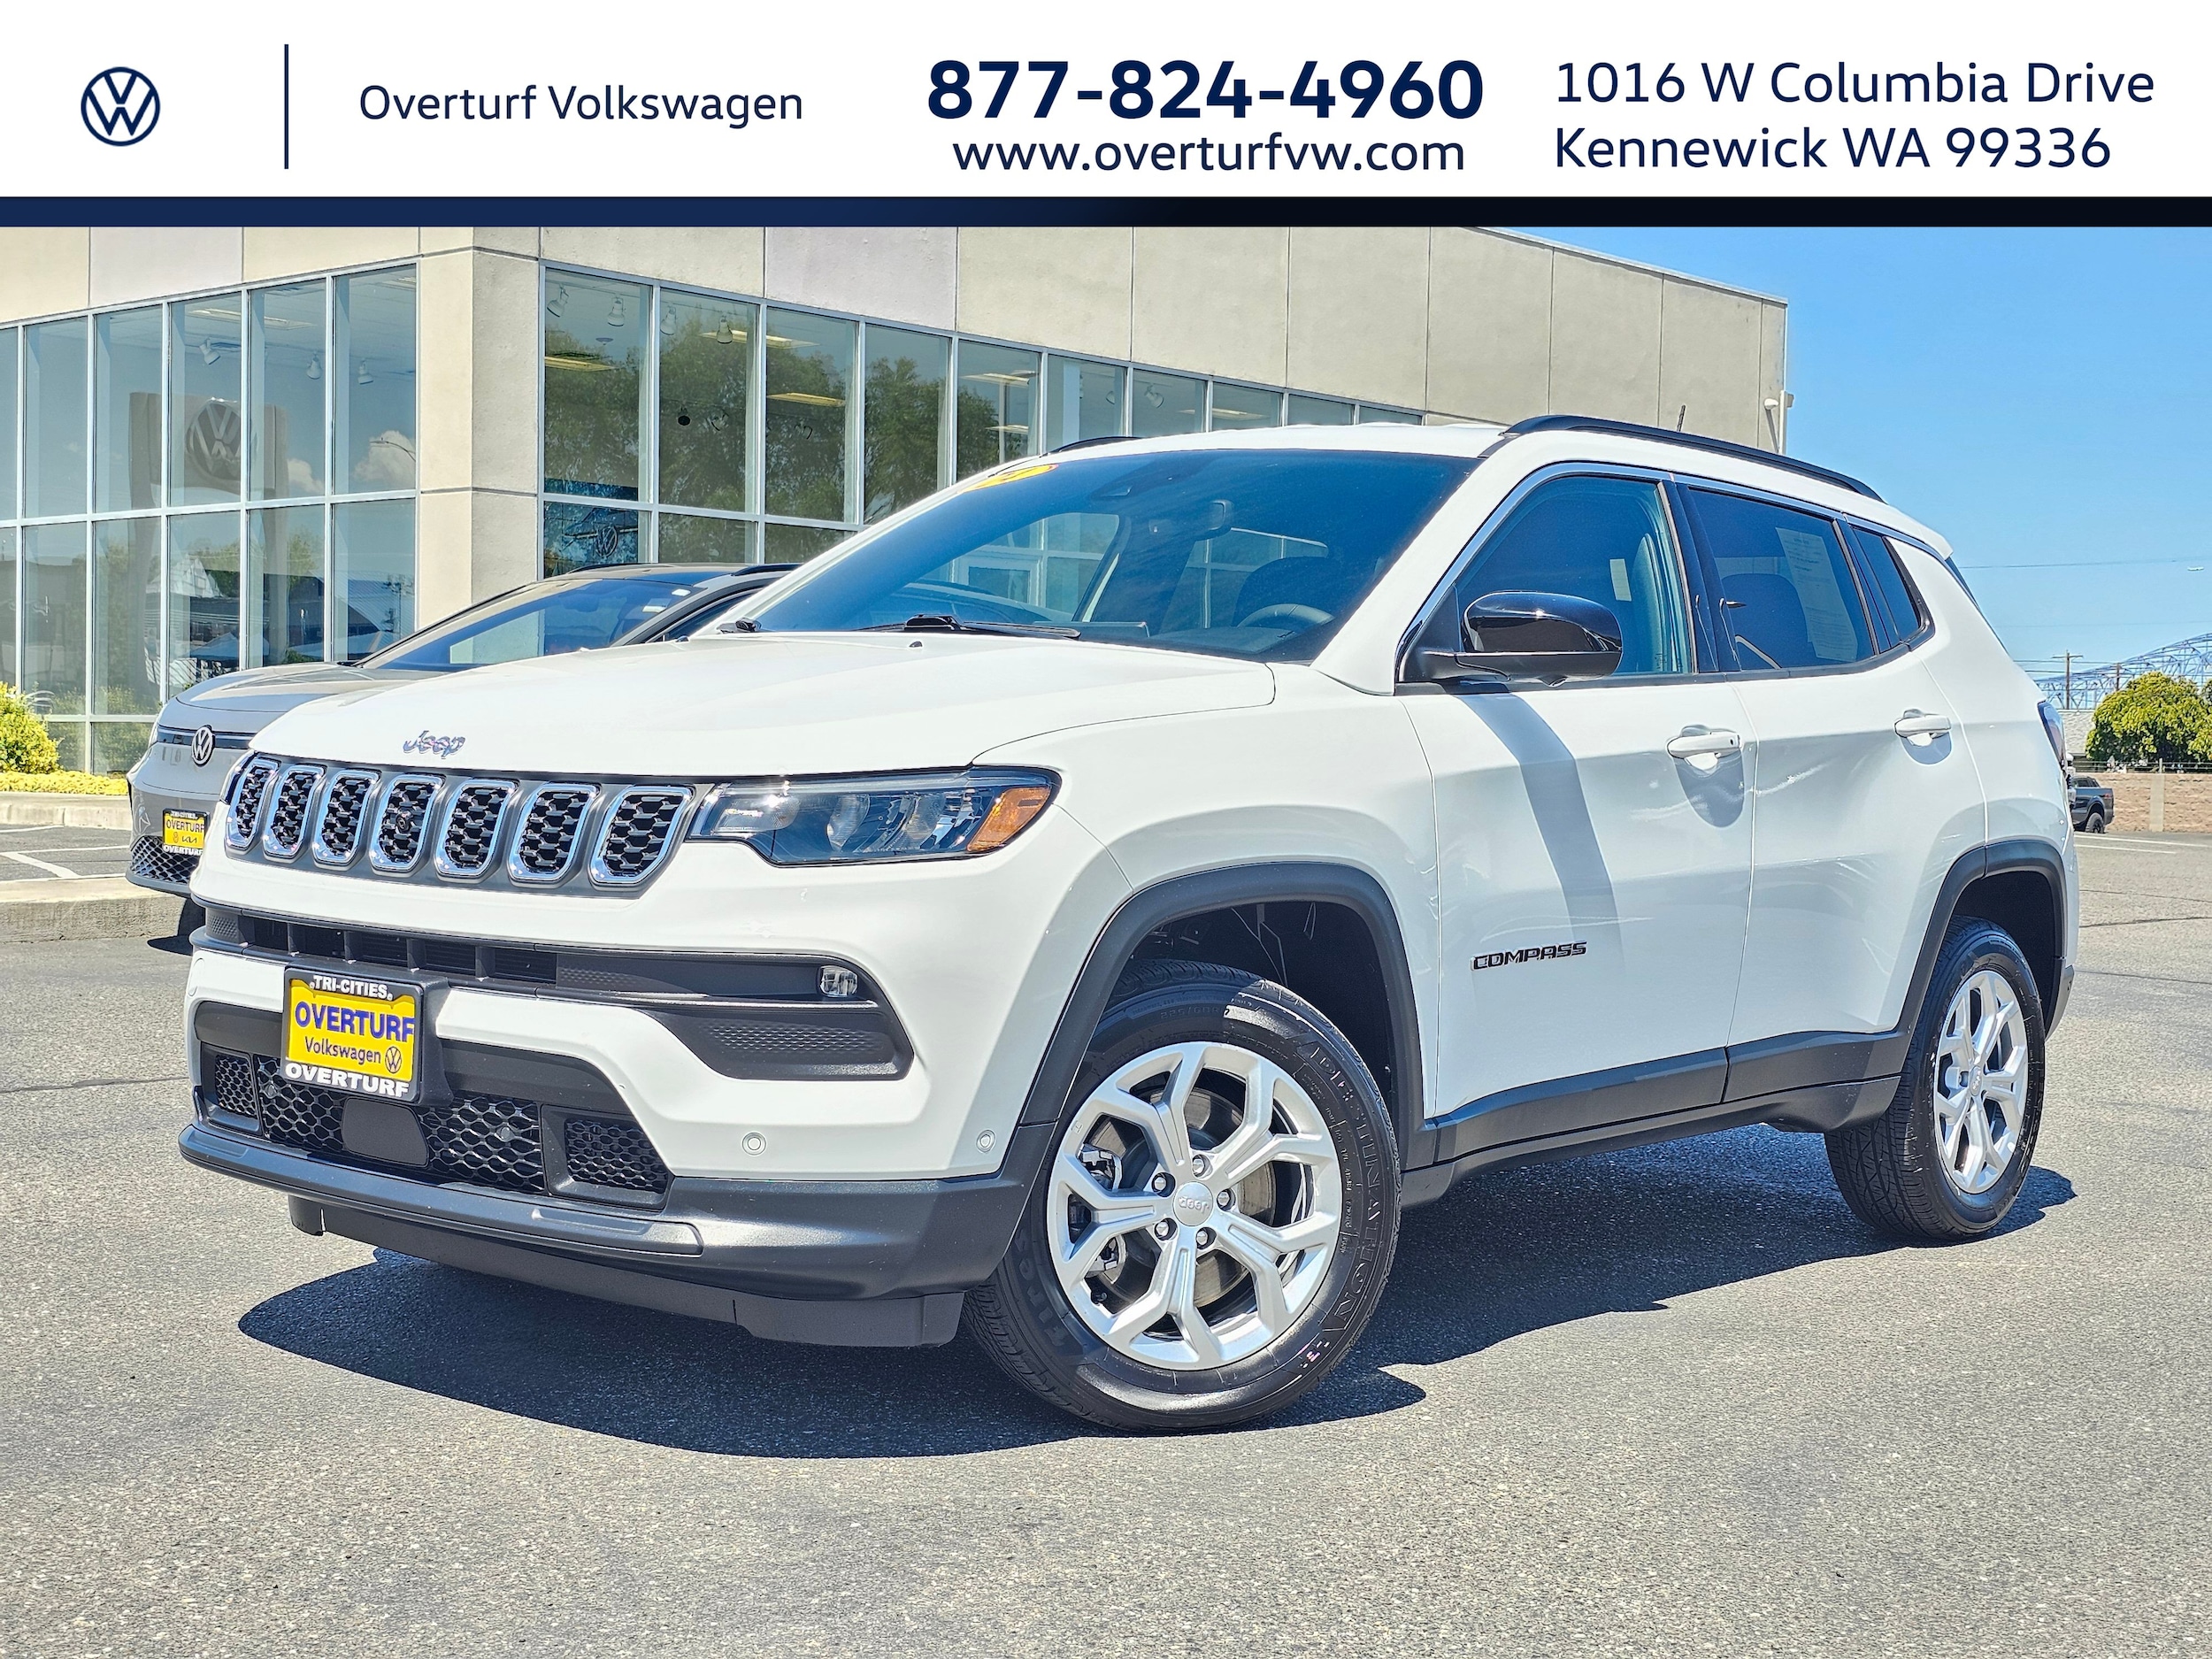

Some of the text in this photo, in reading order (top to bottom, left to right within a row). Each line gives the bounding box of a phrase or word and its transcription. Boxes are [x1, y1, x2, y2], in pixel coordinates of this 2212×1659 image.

[403, 730, 465, 759] Jeep
[165, 819, 204, 833] OVERTURF
[1471, 941, 1587, 970] COMPASS
[312, 975, 388, 1000] TRI-CITIES
[295, 1001, 416, 1042] OVERTURF
[304, 1036, 381, 1065] Volkswagen
[285, 1063, 410, 1098] OVERTURF
